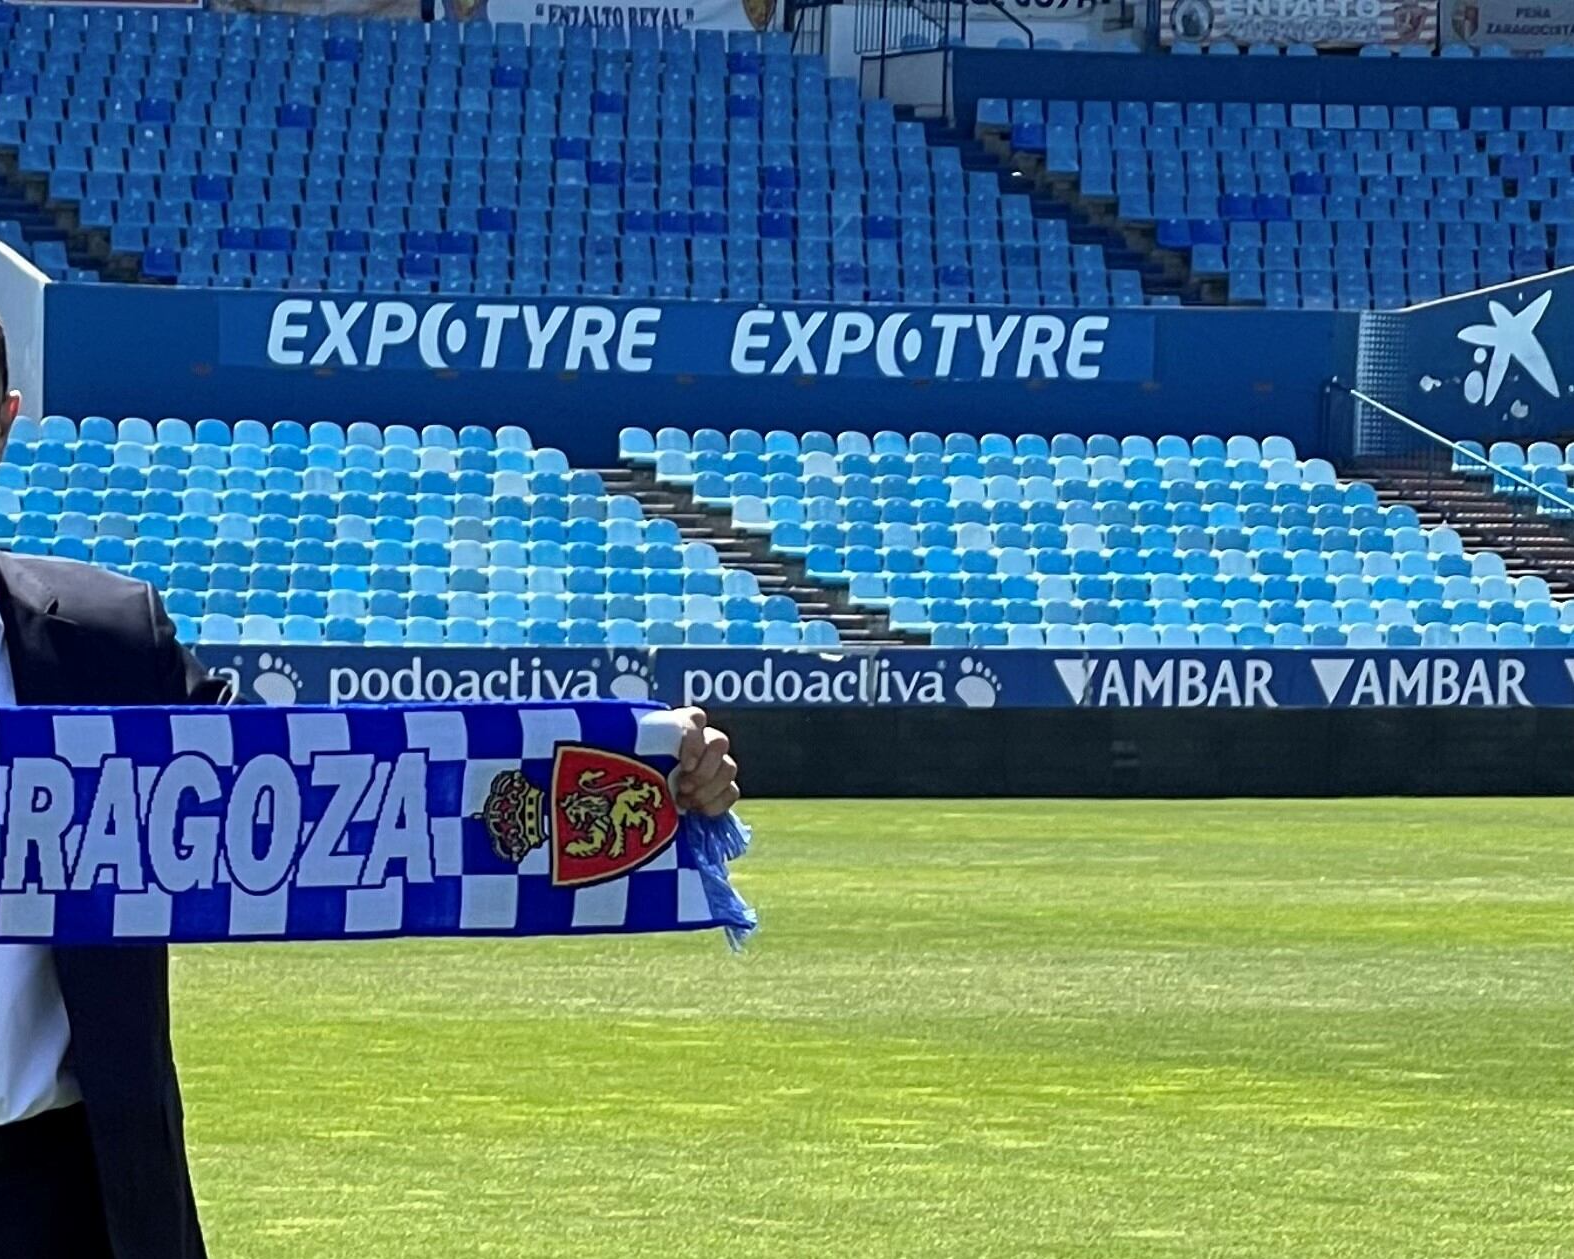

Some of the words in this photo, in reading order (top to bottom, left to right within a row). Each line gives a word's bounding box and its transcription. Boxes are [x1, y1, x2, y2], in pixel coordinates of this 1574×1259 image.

[267, 298, 663, 373] EXPOTYRE
[731, 309, 1110, 380] EXPOTYRE
[329, 656, 598, 707] podoactiva
[683, 657, 947, 707] podoactiva
